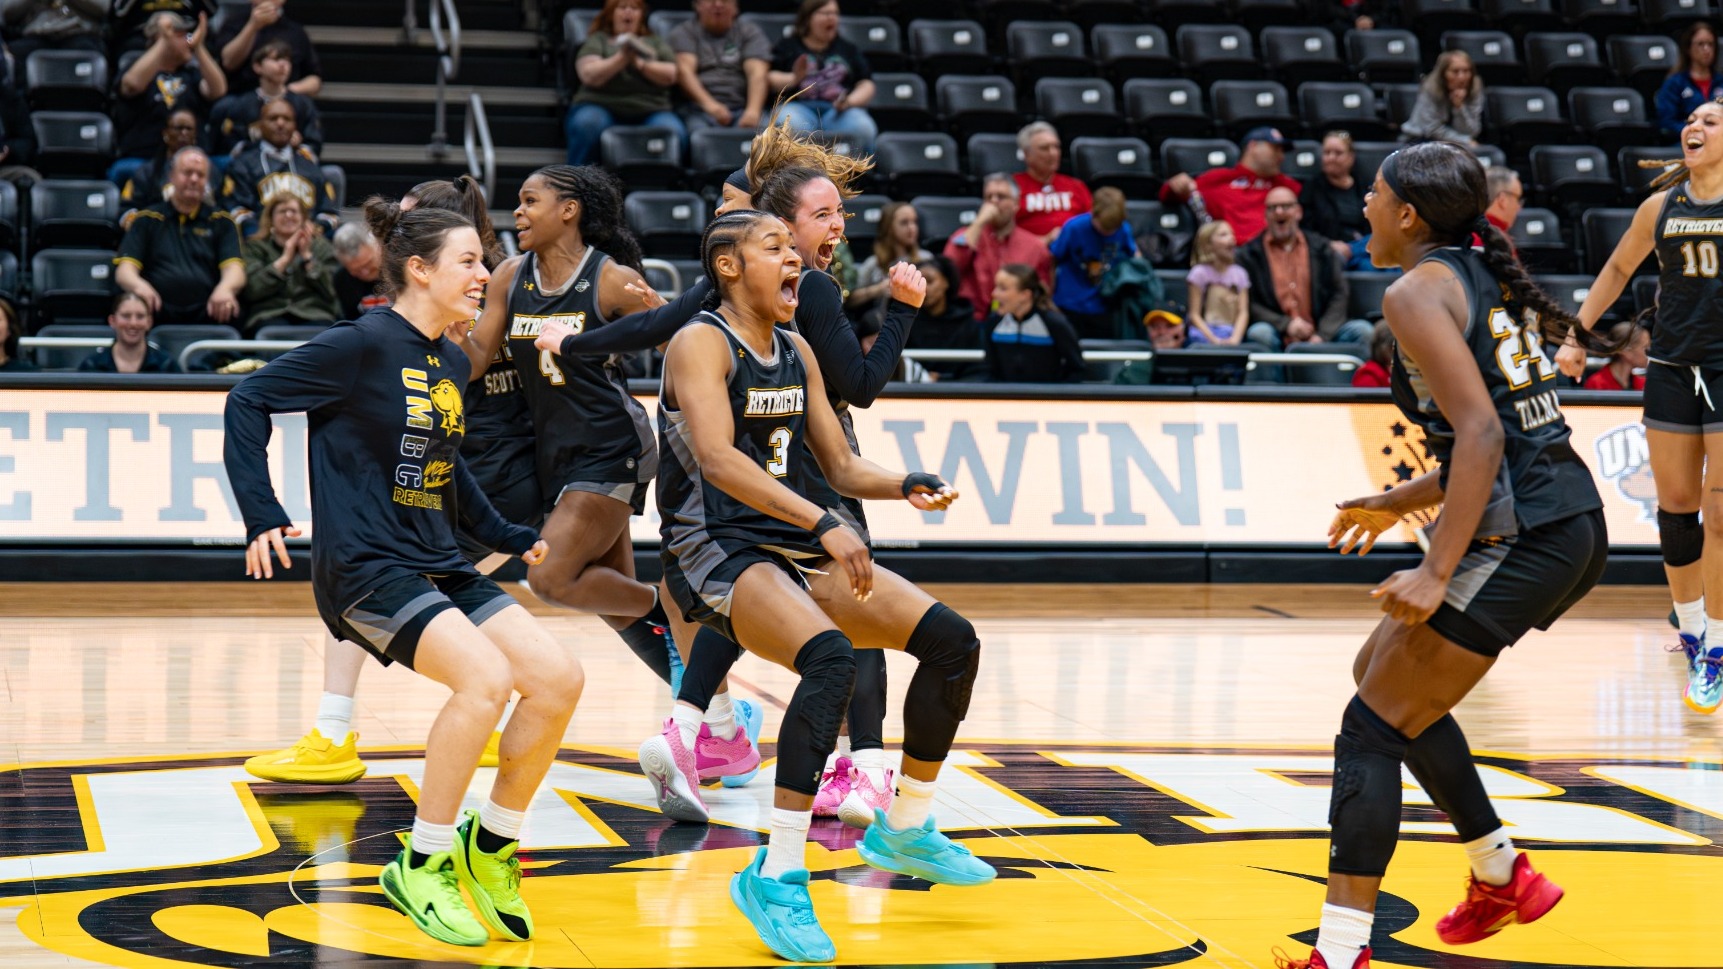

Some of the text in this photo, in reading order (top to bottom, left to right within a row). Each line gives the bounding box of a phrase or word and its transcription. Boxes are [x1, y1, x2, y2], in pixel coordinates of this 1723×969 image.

[1680, 240, 1719, 278] 10
[539, 348, 566, 386] 4
[1488, 307, 1556, 391] 24
[395, 367, 434, 488] UMBC
[766, 426, 793, 479] 3
[882, 420, 1247, 526] WIN!
